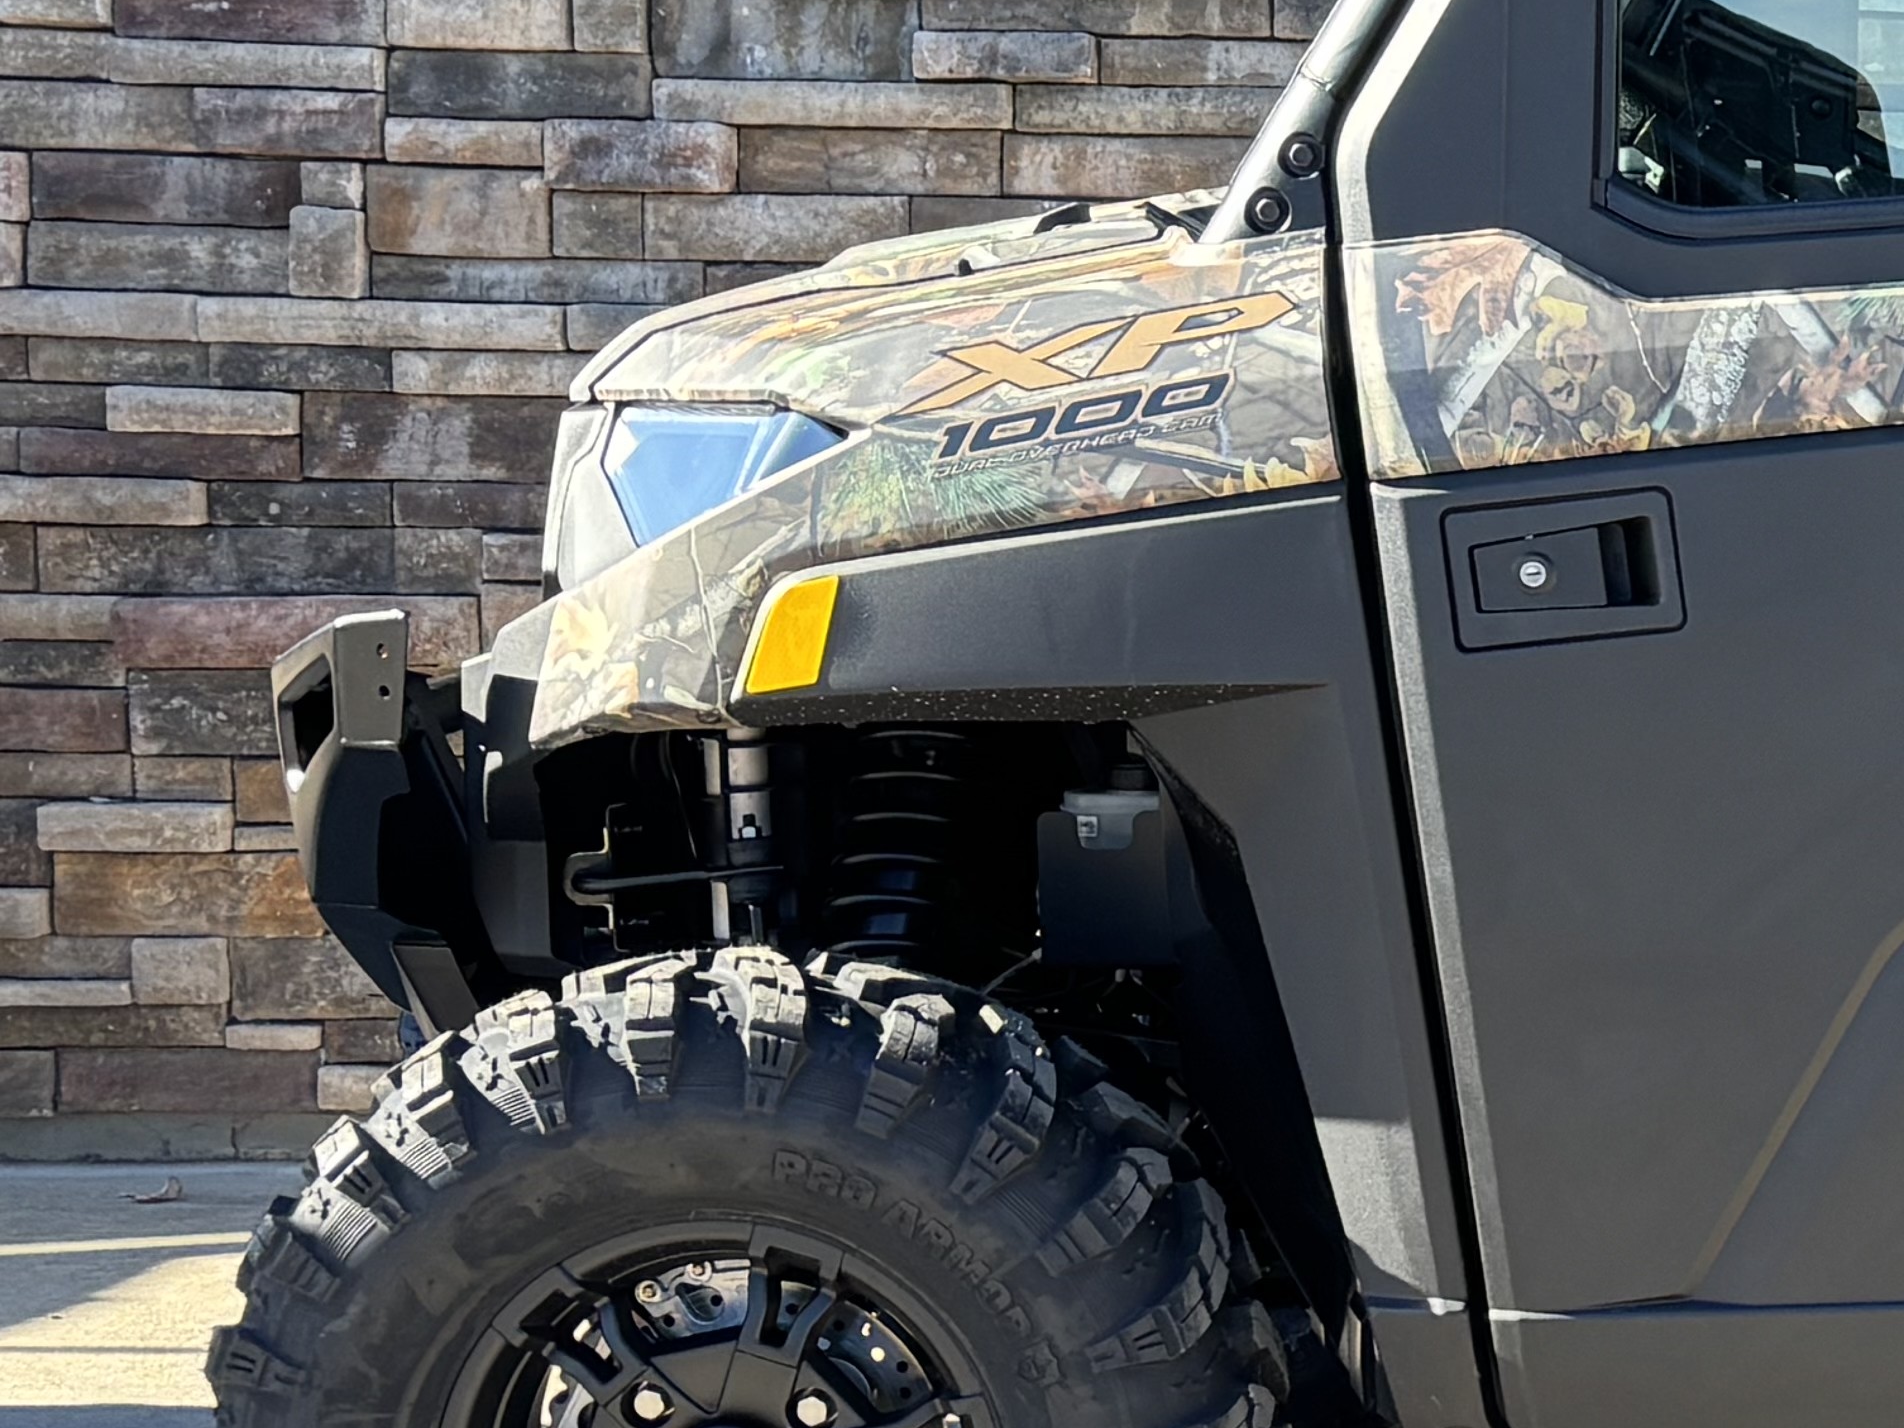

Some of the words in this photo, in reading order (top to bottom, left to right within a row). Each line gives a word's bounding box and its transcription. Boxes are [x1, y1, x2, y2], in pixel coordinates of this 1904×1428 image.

[889, 290, 1297, 416] XP
[933, 457, 1007, 478] DUAL
[1008, 425, 1157, 463] OVERHEAD
[1161, 412, 1222, 433] CAM
[937, 371, 1235, 459] 1000
[771, 1148, 878, 1209] PRO
[879, 1198, 1033, 1342] ARMOR
